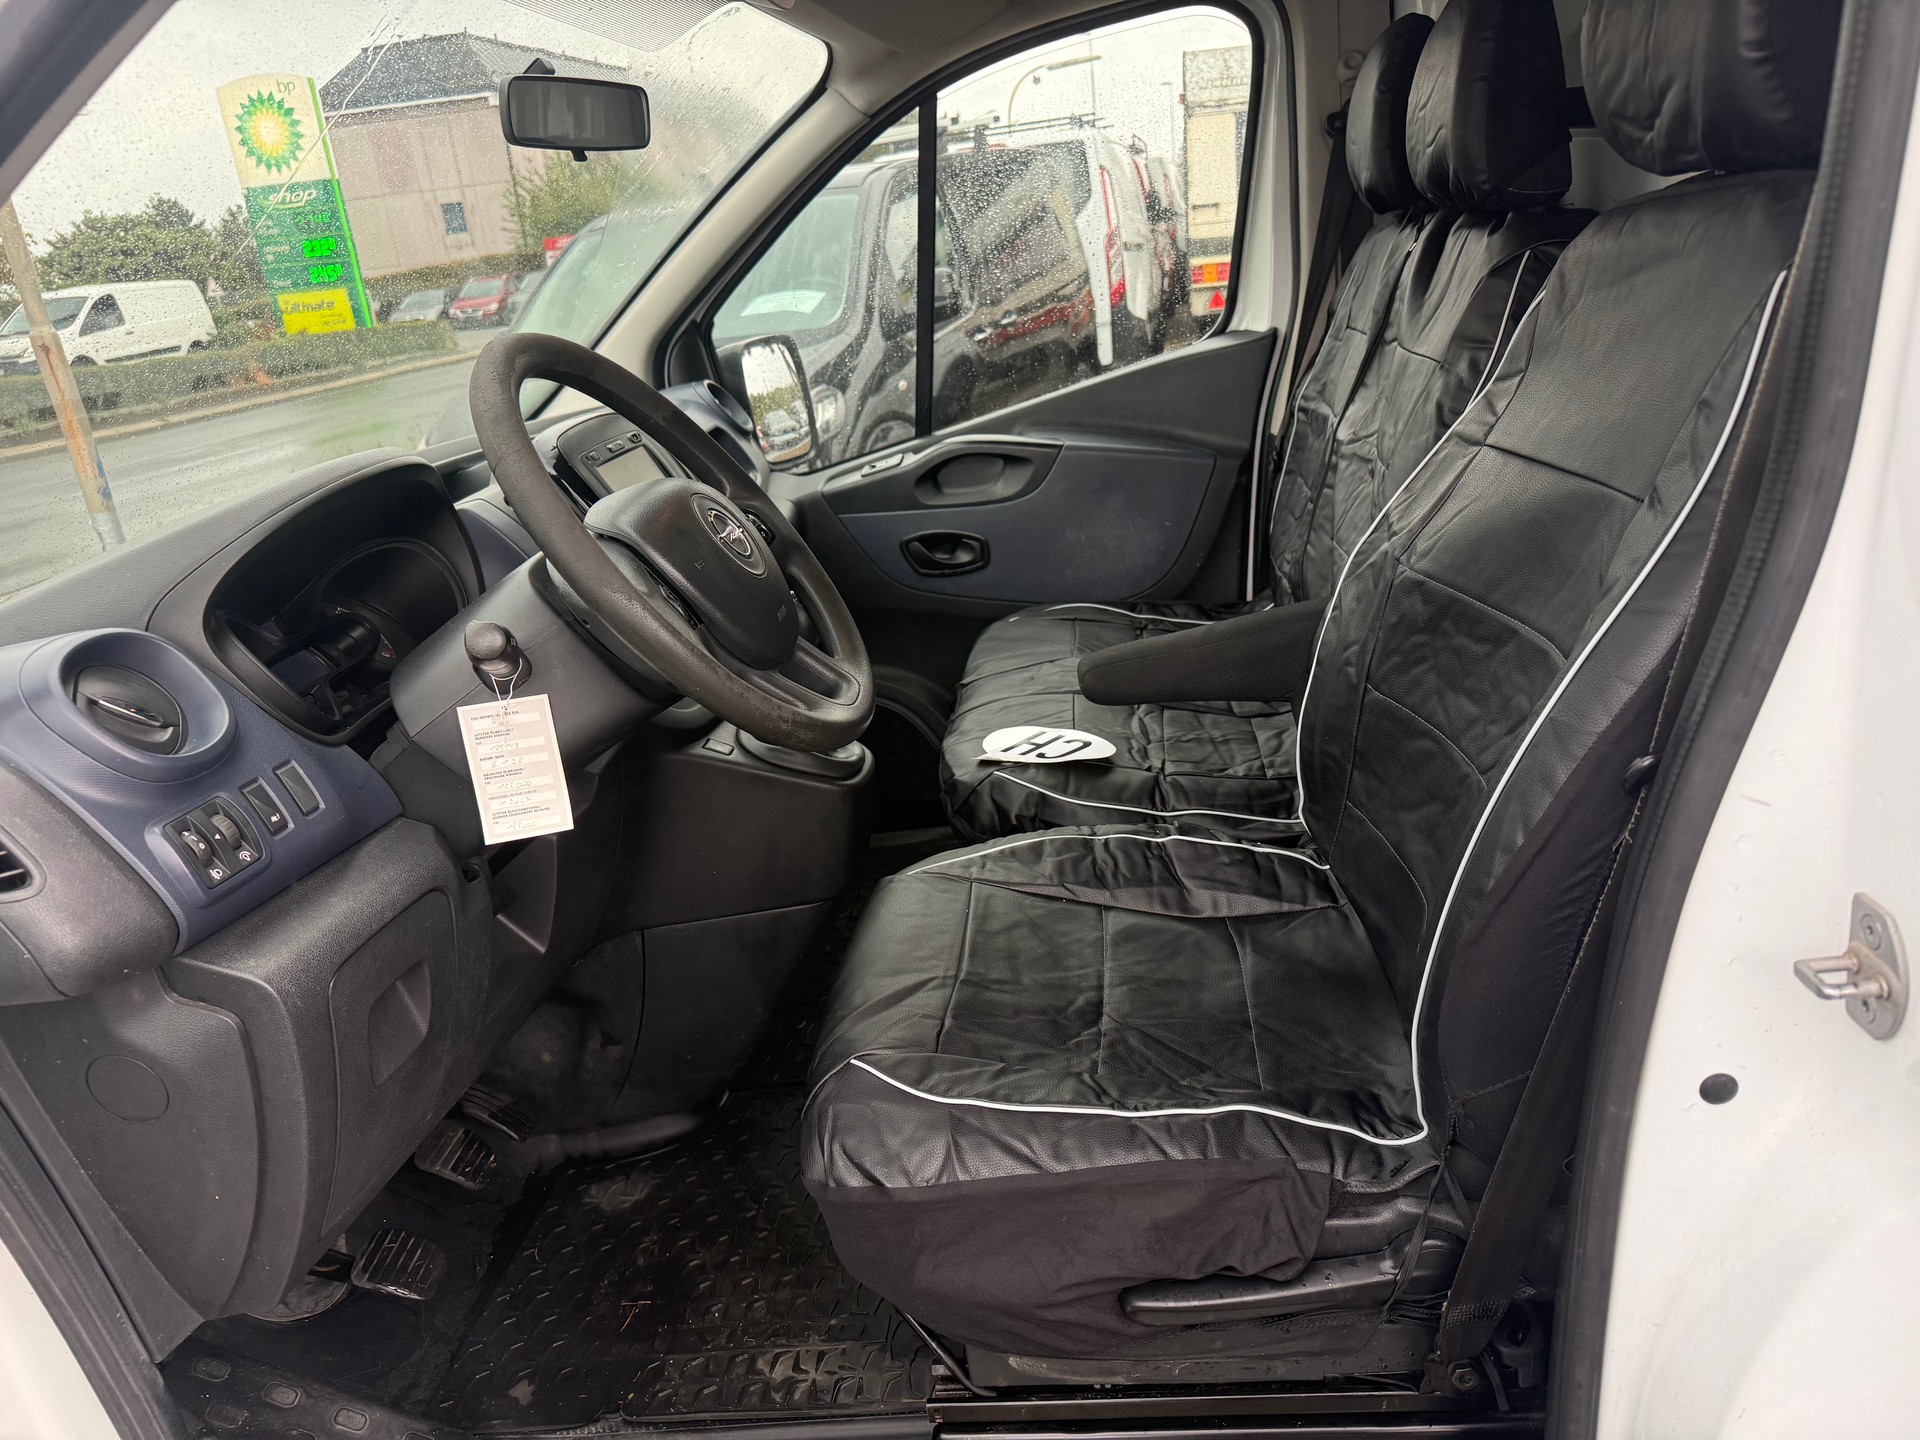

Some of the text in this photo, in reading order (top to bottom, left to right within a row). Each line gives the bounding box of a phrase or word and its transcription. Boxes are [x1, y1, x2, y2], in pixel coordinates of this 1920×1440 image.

[276, 78, 295, 95] bp
[268, 188, 317, 206] shop
[1000, 731, 1092, 758] CH
